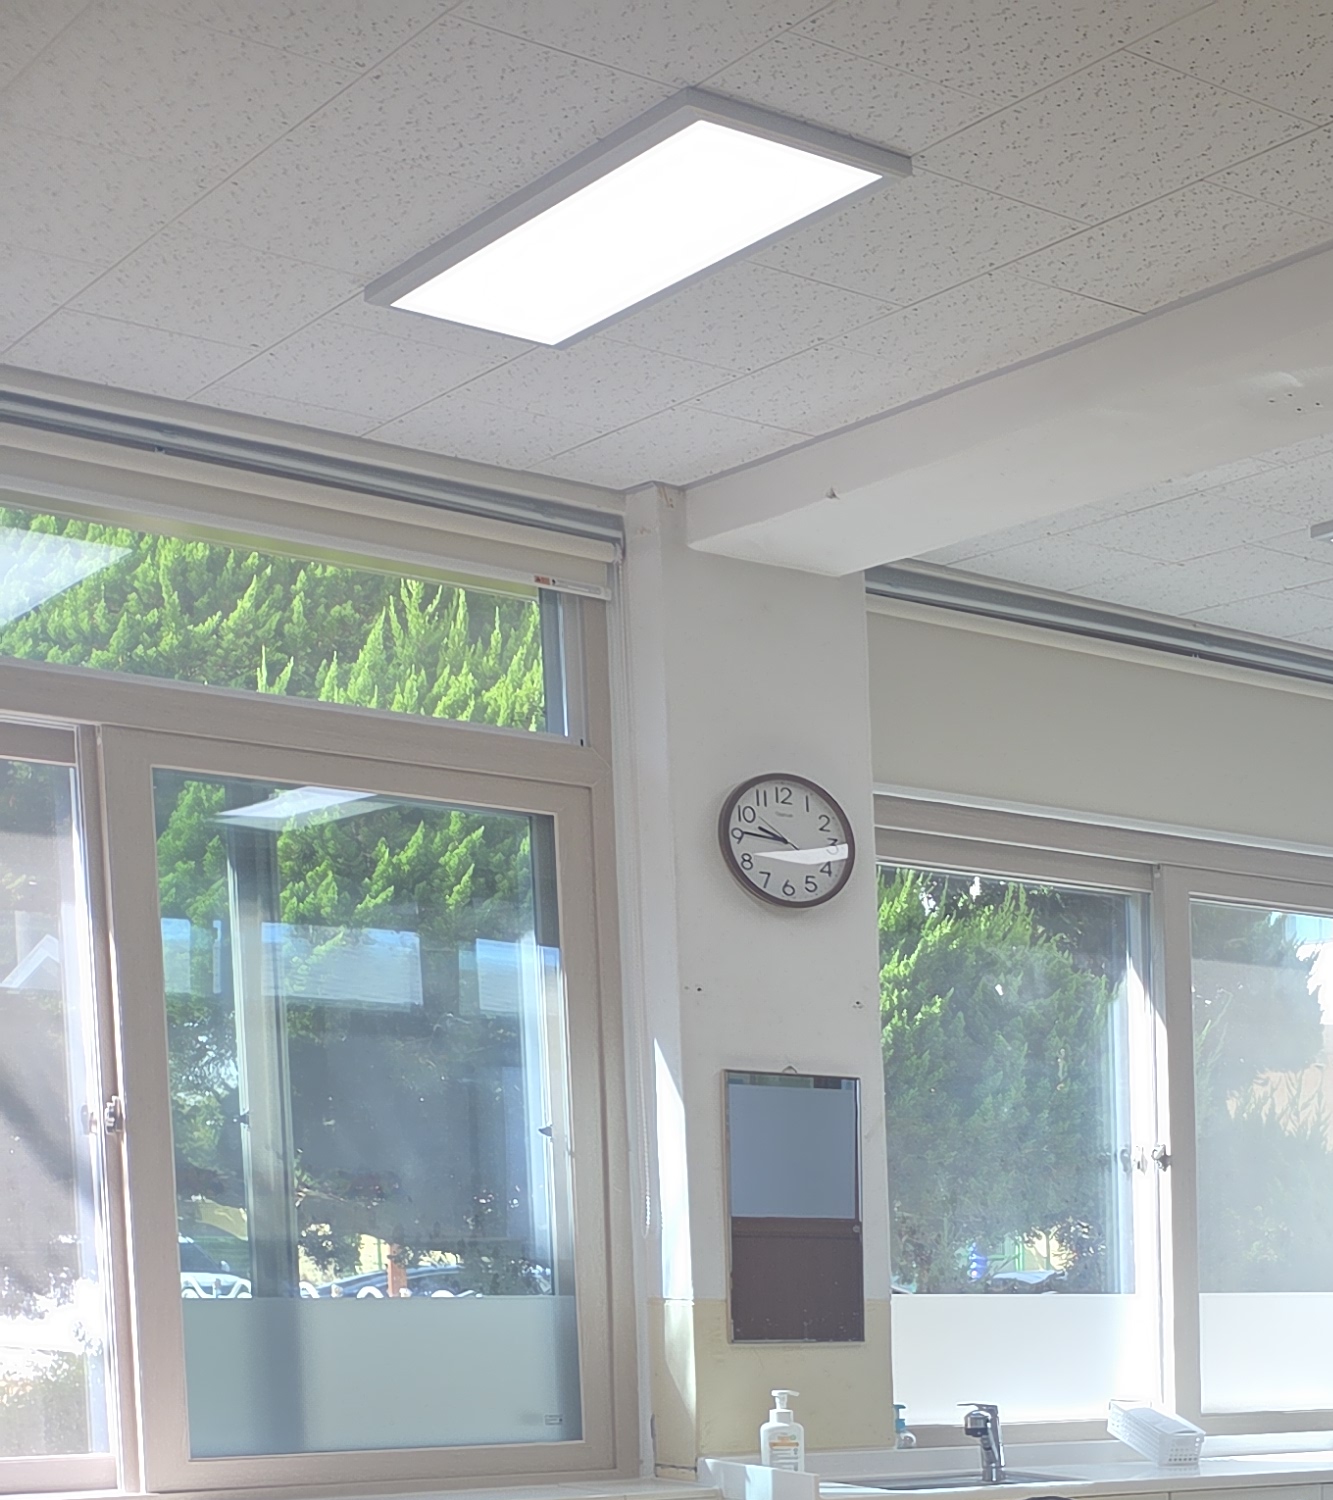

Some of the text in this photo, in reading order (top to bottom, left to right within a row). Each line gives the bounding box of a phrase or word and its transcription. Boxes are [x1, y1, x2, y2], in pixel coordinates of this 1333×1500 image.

[756, 789, 767, 807] 11
[775, 786, 793, 806] 12
[738, 805, 756, 824] 10
[818, 814, 831, 833] 2
[731, 827, 744, 844] 9
[826, 837, 840, 855] 3
[740, 853, 754, 871] 8
[819, 861, 832, 877] 4
[759, 871, 771, 889] 7
[782, 879, 796, 897] 6
[804, 875, 818, 893] 5
